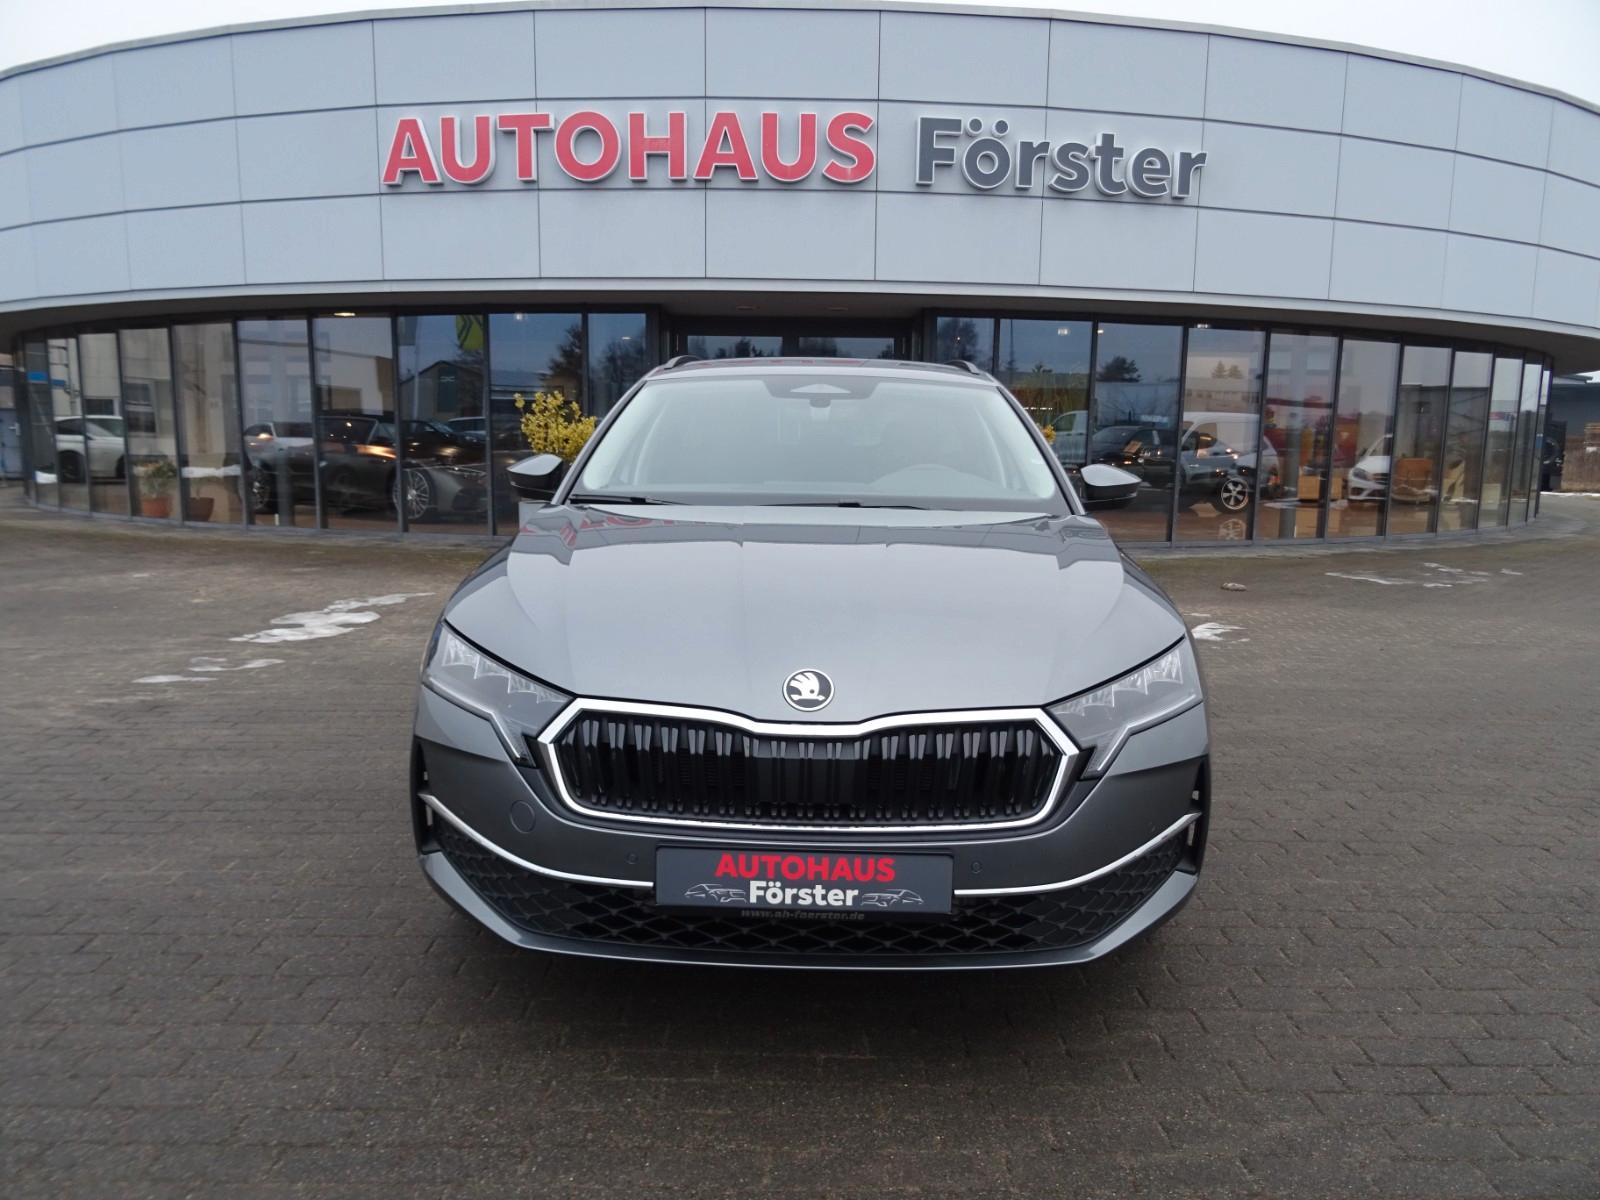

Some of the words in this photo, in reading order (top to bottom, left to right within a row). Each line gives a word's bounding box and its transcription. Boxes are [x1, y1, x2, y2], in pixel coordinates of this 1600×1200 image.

[382, 110, 877, 185] AUTOHAUS
[915, 115, 1207, 199] Förster
[715, 853, 896, 881] AUTOHAUS
[749, 881, 859, 906] Förster
